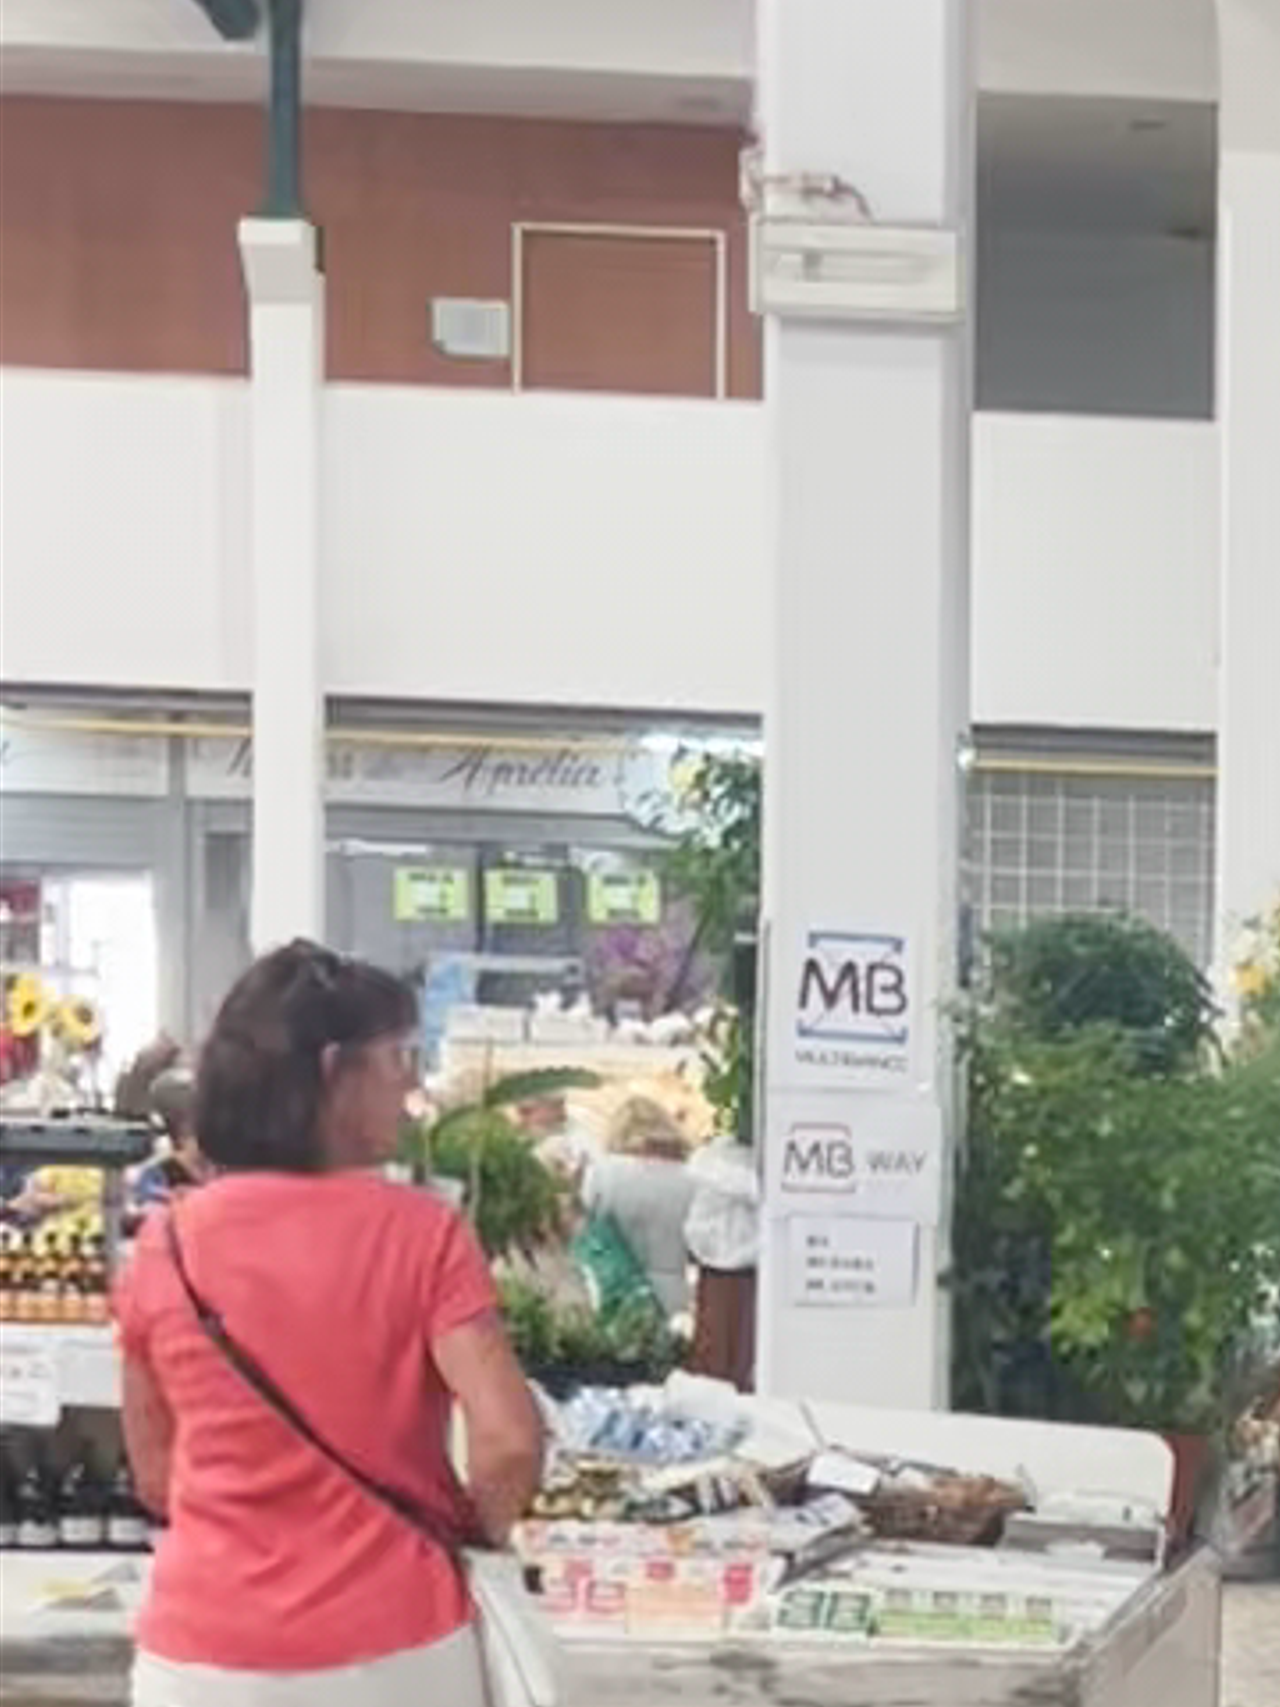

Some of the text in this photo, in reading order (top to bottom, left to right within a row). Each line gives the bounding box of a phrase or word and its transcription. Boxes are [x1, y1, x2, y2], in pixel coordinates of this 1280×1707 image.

[798, 958, 907, 1017] MB
[784, 1140, 926, 1179] MB WAY
